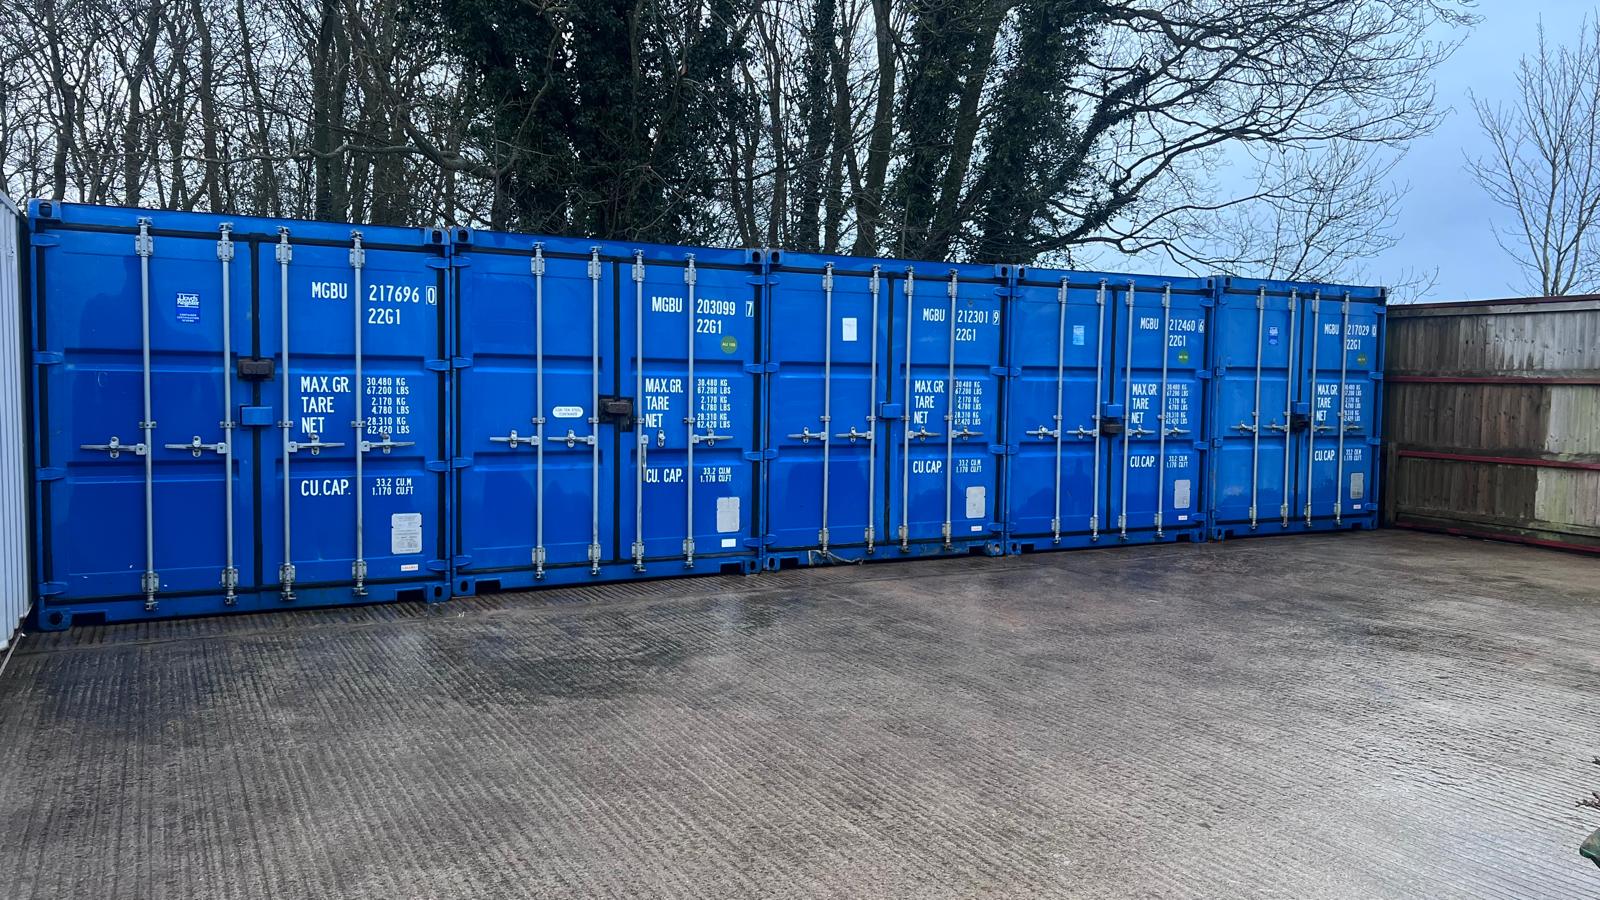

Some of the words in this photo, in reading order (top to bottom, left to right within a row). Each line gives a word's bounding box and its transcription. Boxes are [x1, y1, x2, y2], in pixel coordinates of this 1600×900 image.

[312, 282, 347, 299] MGBU
[369, 285, 419, 302] 217696
[427, 287, 436, 304] 0
[652, 297, 682, 312] MGBU
[697, 299, 735, 315] 203099
[368, 308, 400, 324] 22G1
[923, 309, 945, 321] MGBU
[958, 310, 988, 323] 212301
[697, 319, 722, 334] 22G1
[1141, 318, 1159, 330] MGBU
[1169, 320, 1195, 331] 212460
[1324, 324, 1339, 335] MGBU
[1347, 325, 1369, 336] 217029
[956, 329, 976, 341] 22G1
[1169, 335, 1186, 347] 22G1
[1347, 340, 1360, 350] 22G1
[301, 377, 351, 392] MAX.GR.
[367, 378, 392, 386] 30.480
[396, 378, 405, 386] KG
[645, 379, 683, 393] MAX.GR.
[396, 387, 409, 395] LBS
[302, 397, 334, 413] TARE
[646, 396, 669, 410] TARE
[915, 396, 934, 408] TARE
[1133, 398, 1149, 409] TARE
[1318, 397, 1331, 408] TARE
[372, 406, 392, 414] 4.780
[396, 406, 409, 414] LBS
[1317, 410, 1327, 421] NET
[646, 414, 663, 428] NET
[914, 411, 928, 424] NET
[1131, 412, 1144, 424] NET
[302, 417, 324, 433] NET
[367, 417, 392, 425] 28.310
[396, 417, 406, 425] KG
[367, 426, 392, 434] 62.420
[396, 426, 409, 434] LBS
[913, 461, 942, 473] CU.CAP.
[1130, 456, 1155, 468] CU.CAP.
[664, 468, 683, 483] CAP.
[700, 475, 715, 483] 1.170
[301, 480, 351, 495] CU.CAP.
[376, 478, 392, 486] 33.2
[396, 478, 411, 486] CU.M
[372, 487, 392, 495] 1.170
